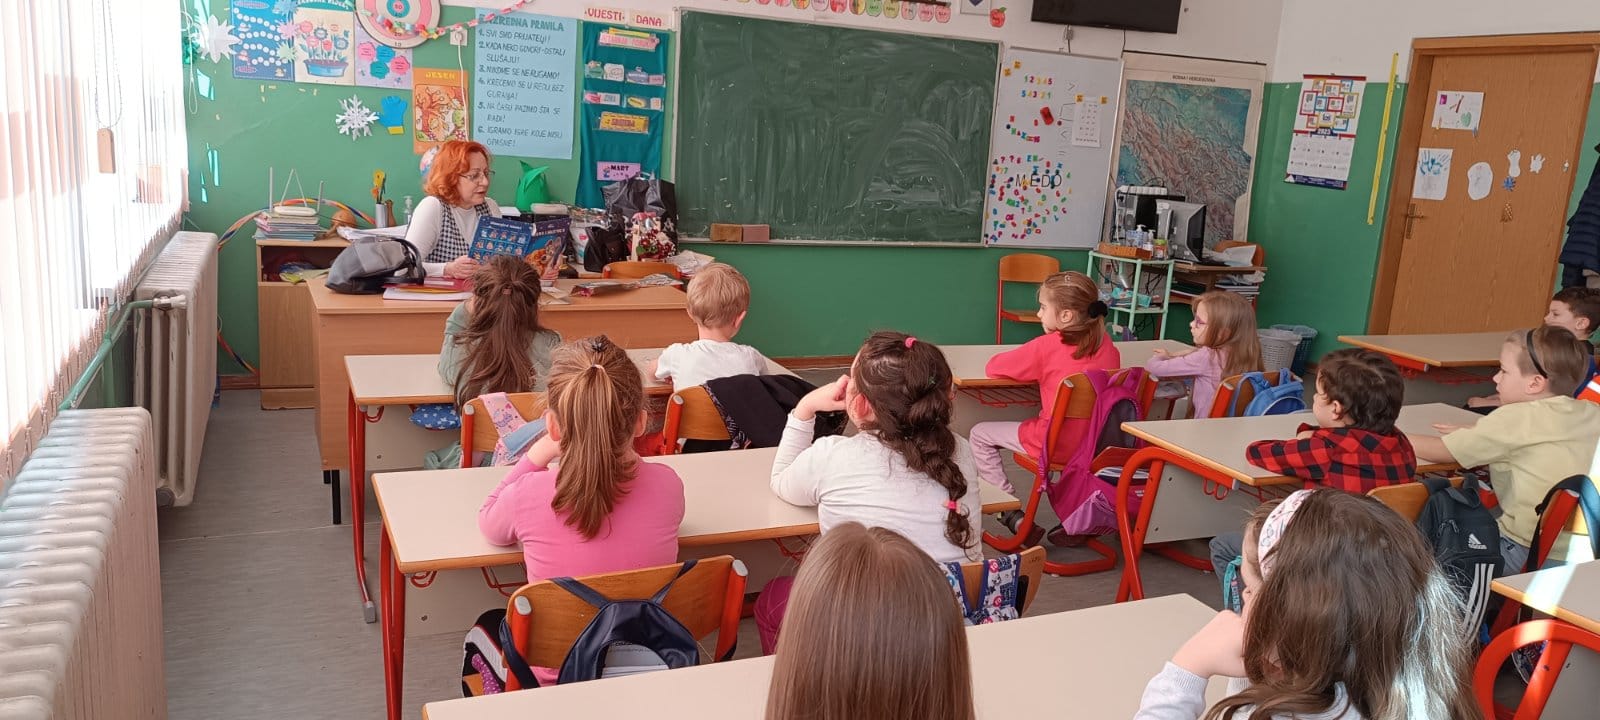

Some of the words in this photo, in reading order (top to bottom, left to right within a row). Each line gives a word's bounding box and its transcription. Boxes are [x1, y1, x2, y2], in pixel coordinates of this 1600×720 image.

[530, 18, 564, 31] PRAVILA
[636, 15, 662, 26] DANA
[486, 30, 496, 38] SVI
[499, 31, 512, 39] SMO
[486, 42, 502, 50] KADA
[503, 43, 518, 52] NEKO
[520, 45, 540, 54] GOVORI
[425, 71, 455, 80] JESEN
[512, 67, 520, 76] SE
[518, 80, 525, 89] SE
[552, 84, 564, 92] BEZ
[514, 104, 538, 113] PAZIMO
[553, 107, 560, 115] SE
[487, 126, 512, 135] IGRAMO
[514, 128, 529, 137] IGRE
[531, 129, 547, 138] KOJE
[1016, 174, 1062, 187] MEDO
